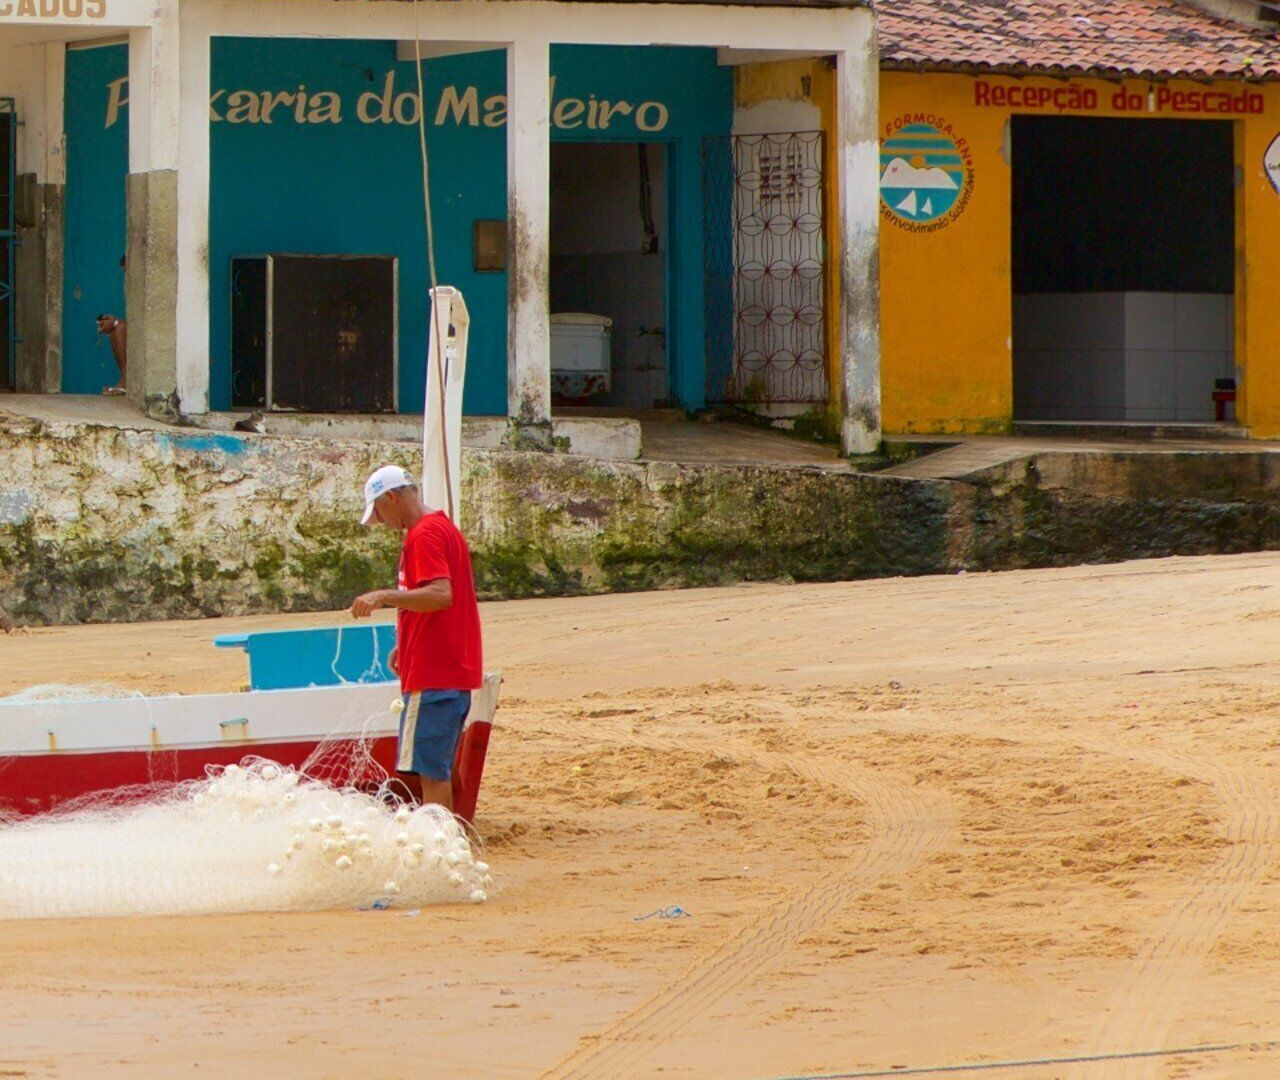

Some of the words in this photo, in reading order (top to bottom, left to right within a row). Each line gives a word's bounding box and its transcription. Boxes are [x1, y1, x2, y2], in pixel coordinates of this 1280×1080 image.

[104, 76, 343, 130] Pxaria
[356, 70, 422, 125] do
[434, 76, 669, 132] Maeiro
[974, 80, 1098, 113] Recepção
[1112, 85, 1143, 111] do
[1157, 84, 1264, 114] Pescado
